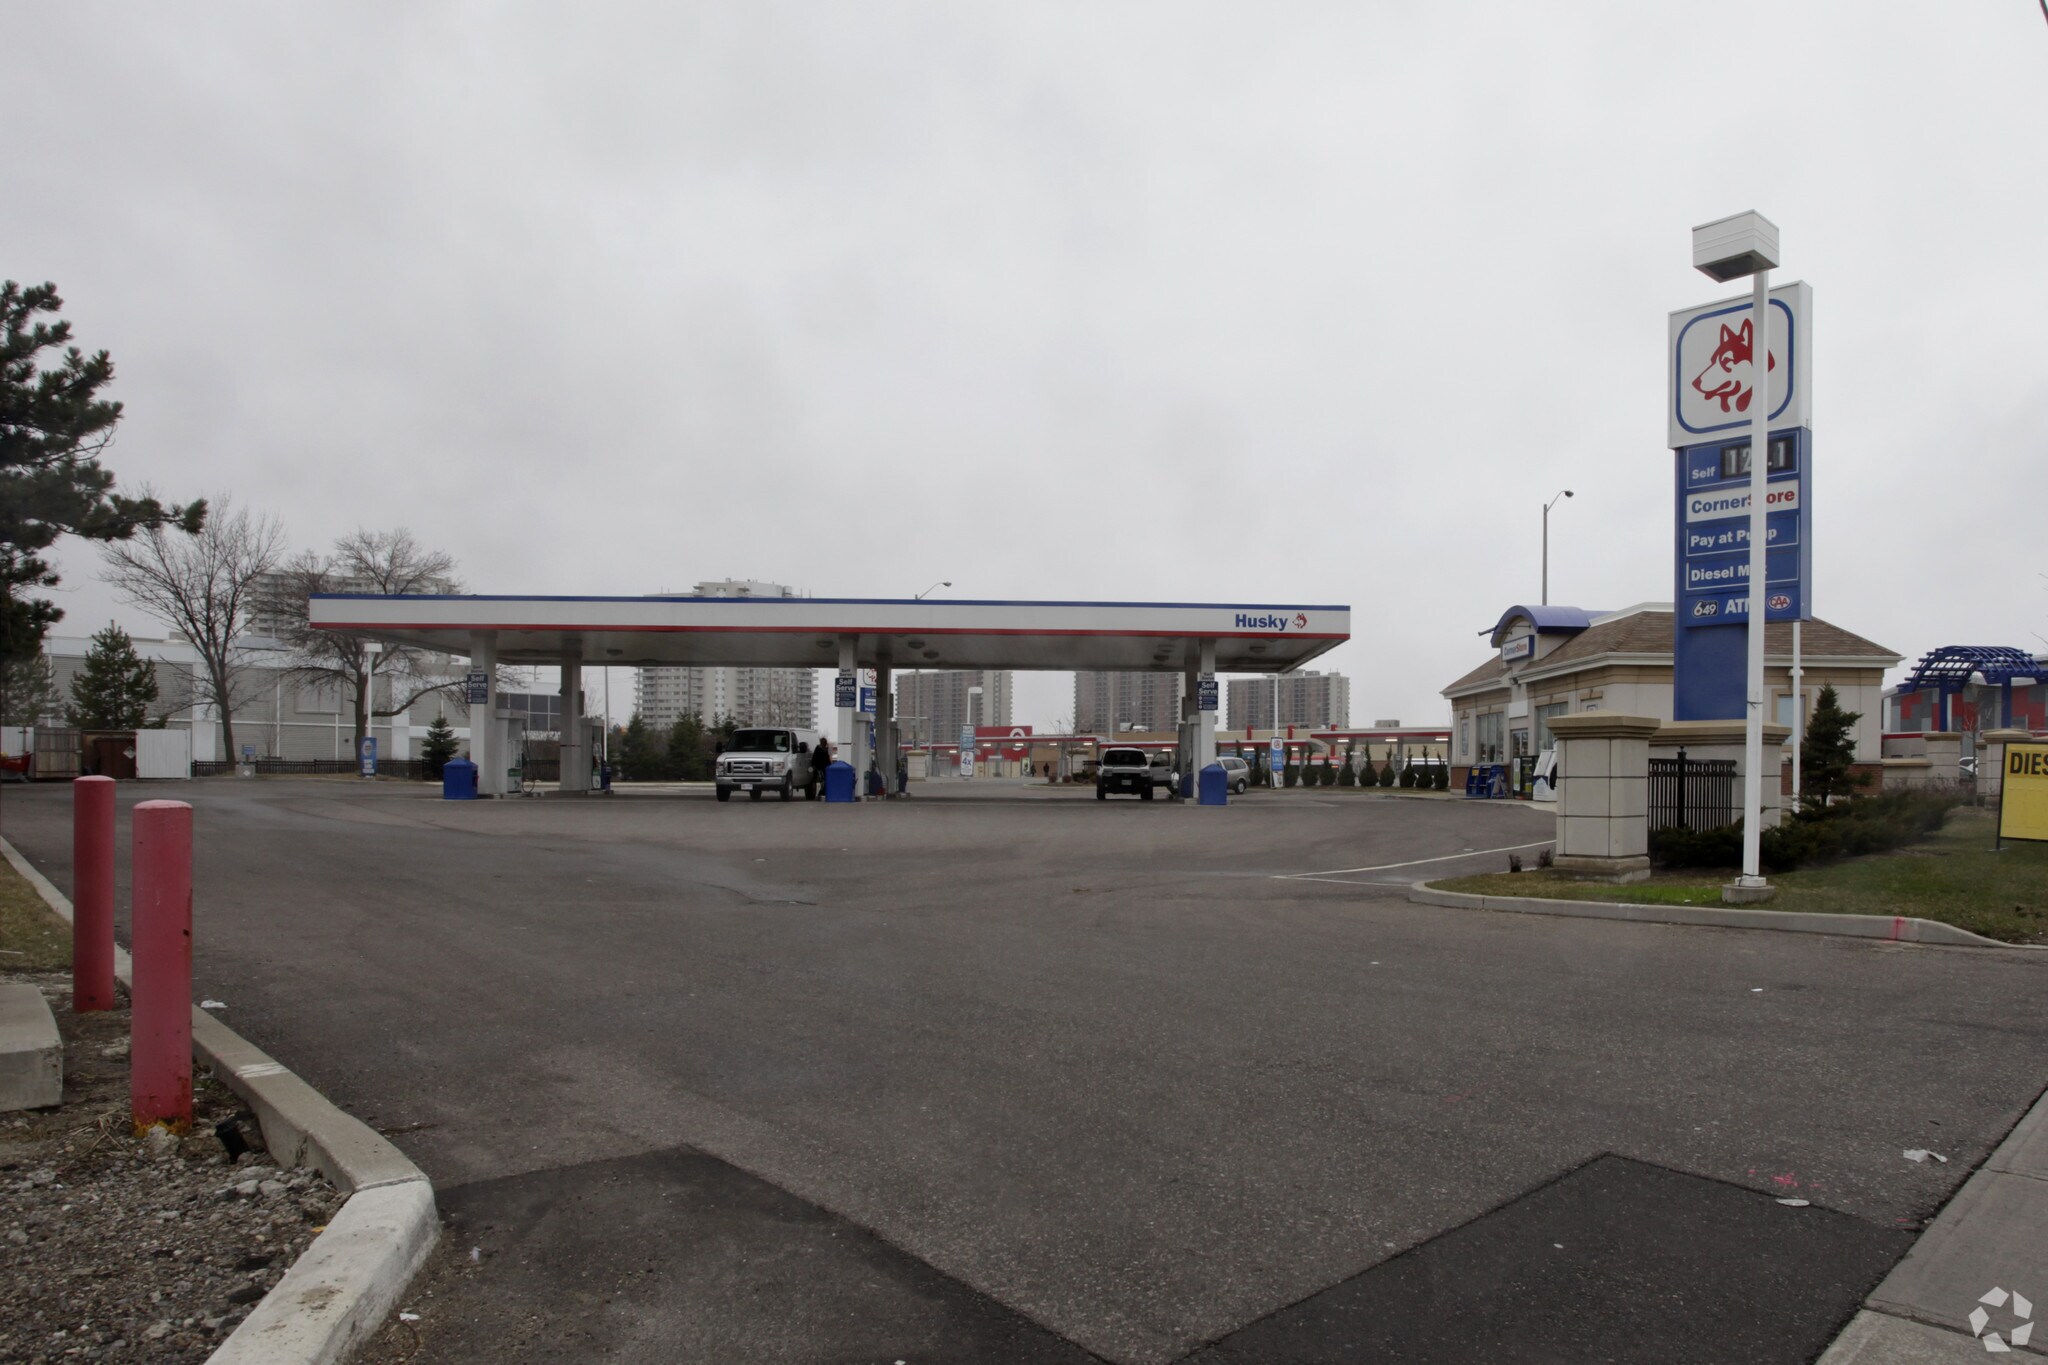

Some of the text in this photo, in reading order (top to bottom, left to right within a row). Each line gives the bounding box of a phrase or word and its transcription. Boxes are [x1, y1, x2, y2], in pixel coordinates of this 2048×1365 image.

[1730, 441, 1785, 474] 12.1
[1692, 466, 1716, 480] Self
[1692, 490, 1795, 514] Cornerore
[1691, 535, 1715, 549] Pay
[1719, 531, 1733, 543] at
[1691, 566, 1734, 581] Diesel
[1770, 596, 1788, 608] CAA
[1235, 613, 1288, 631] Husky
